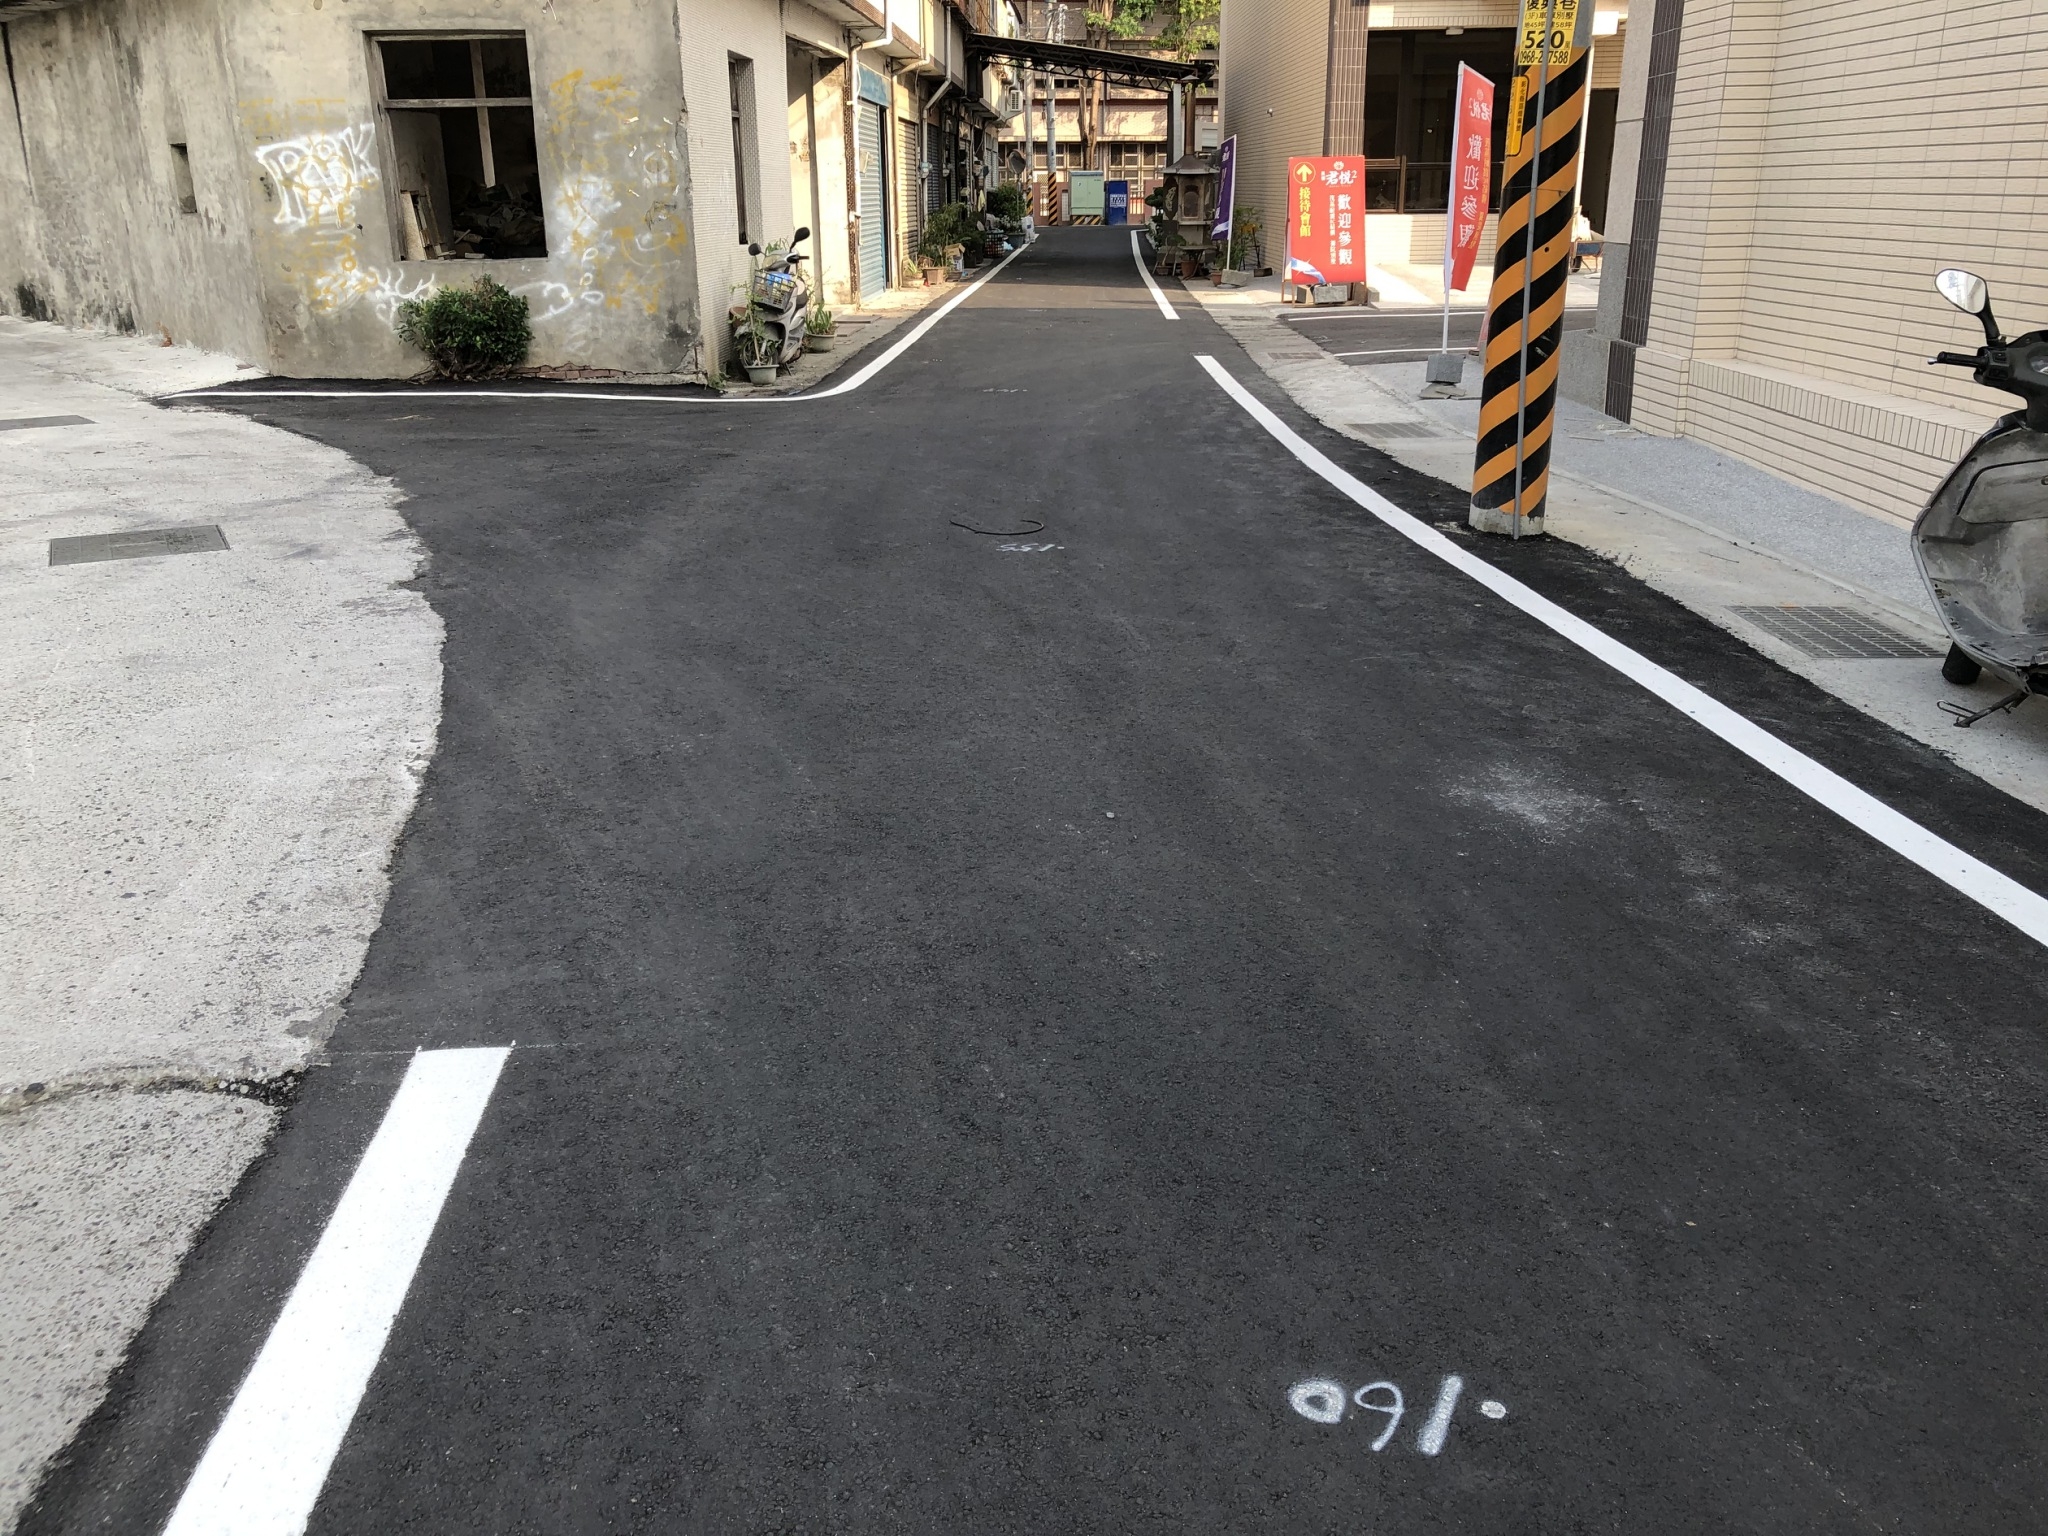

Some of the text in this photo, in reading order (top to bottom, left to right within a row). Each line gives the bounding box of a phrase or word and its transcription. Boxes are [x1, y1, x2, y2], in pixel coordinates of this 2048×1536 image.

[1524, 30, 1565, 49] 520
[1519, 50, 1569, 64] 0968-27588
[1299, 187, 1311, 237] 接待會館
[1337, 193, 1353, 265] 歡迎參觀
